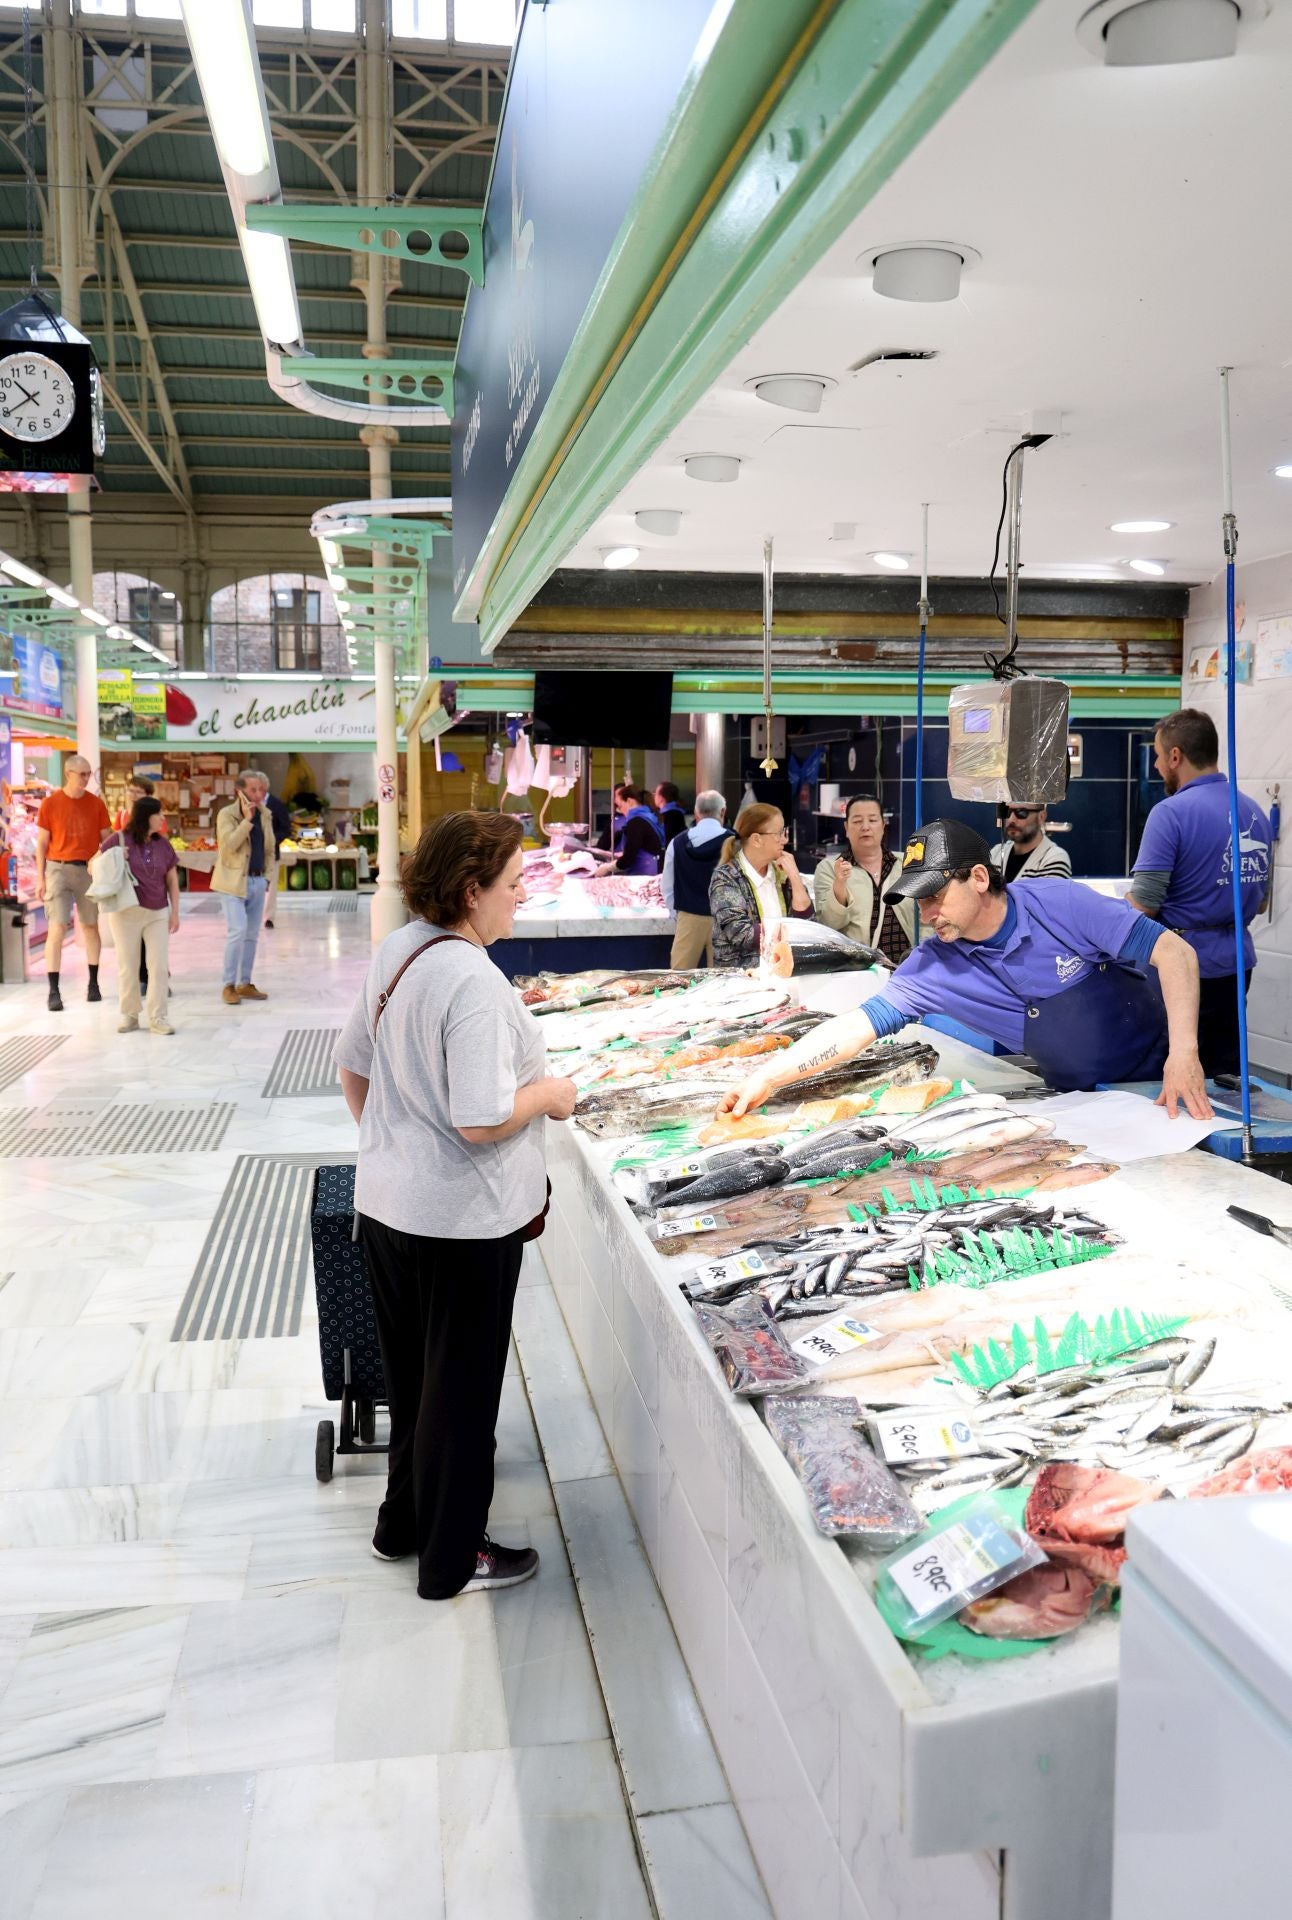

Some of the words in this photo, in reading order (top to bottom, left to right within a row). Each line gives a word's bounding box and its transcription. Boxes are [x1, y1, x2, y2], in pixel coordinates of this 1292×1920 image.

[11, 368, 20, 378] 11
[24, 365, 36, 375] 12
[43, 370, 47, 380] 1
[0, 378, 12, 388] 10
[52, 380, 61, 390] 2
[0, 392, 6, 402] 9
[56, 394, 64, 404] 3
[2, 407, 11, 418] 8
[53, 409, 61, 418] 4
[15, 417, 23, 427] 7
[28, 421, 37, 432] 6
[43, 418, 51, 428] 5
[198, 709, 222, 736] el
[233, 684, 346, 729] chavalín
[314, 723, 334, 734] del
